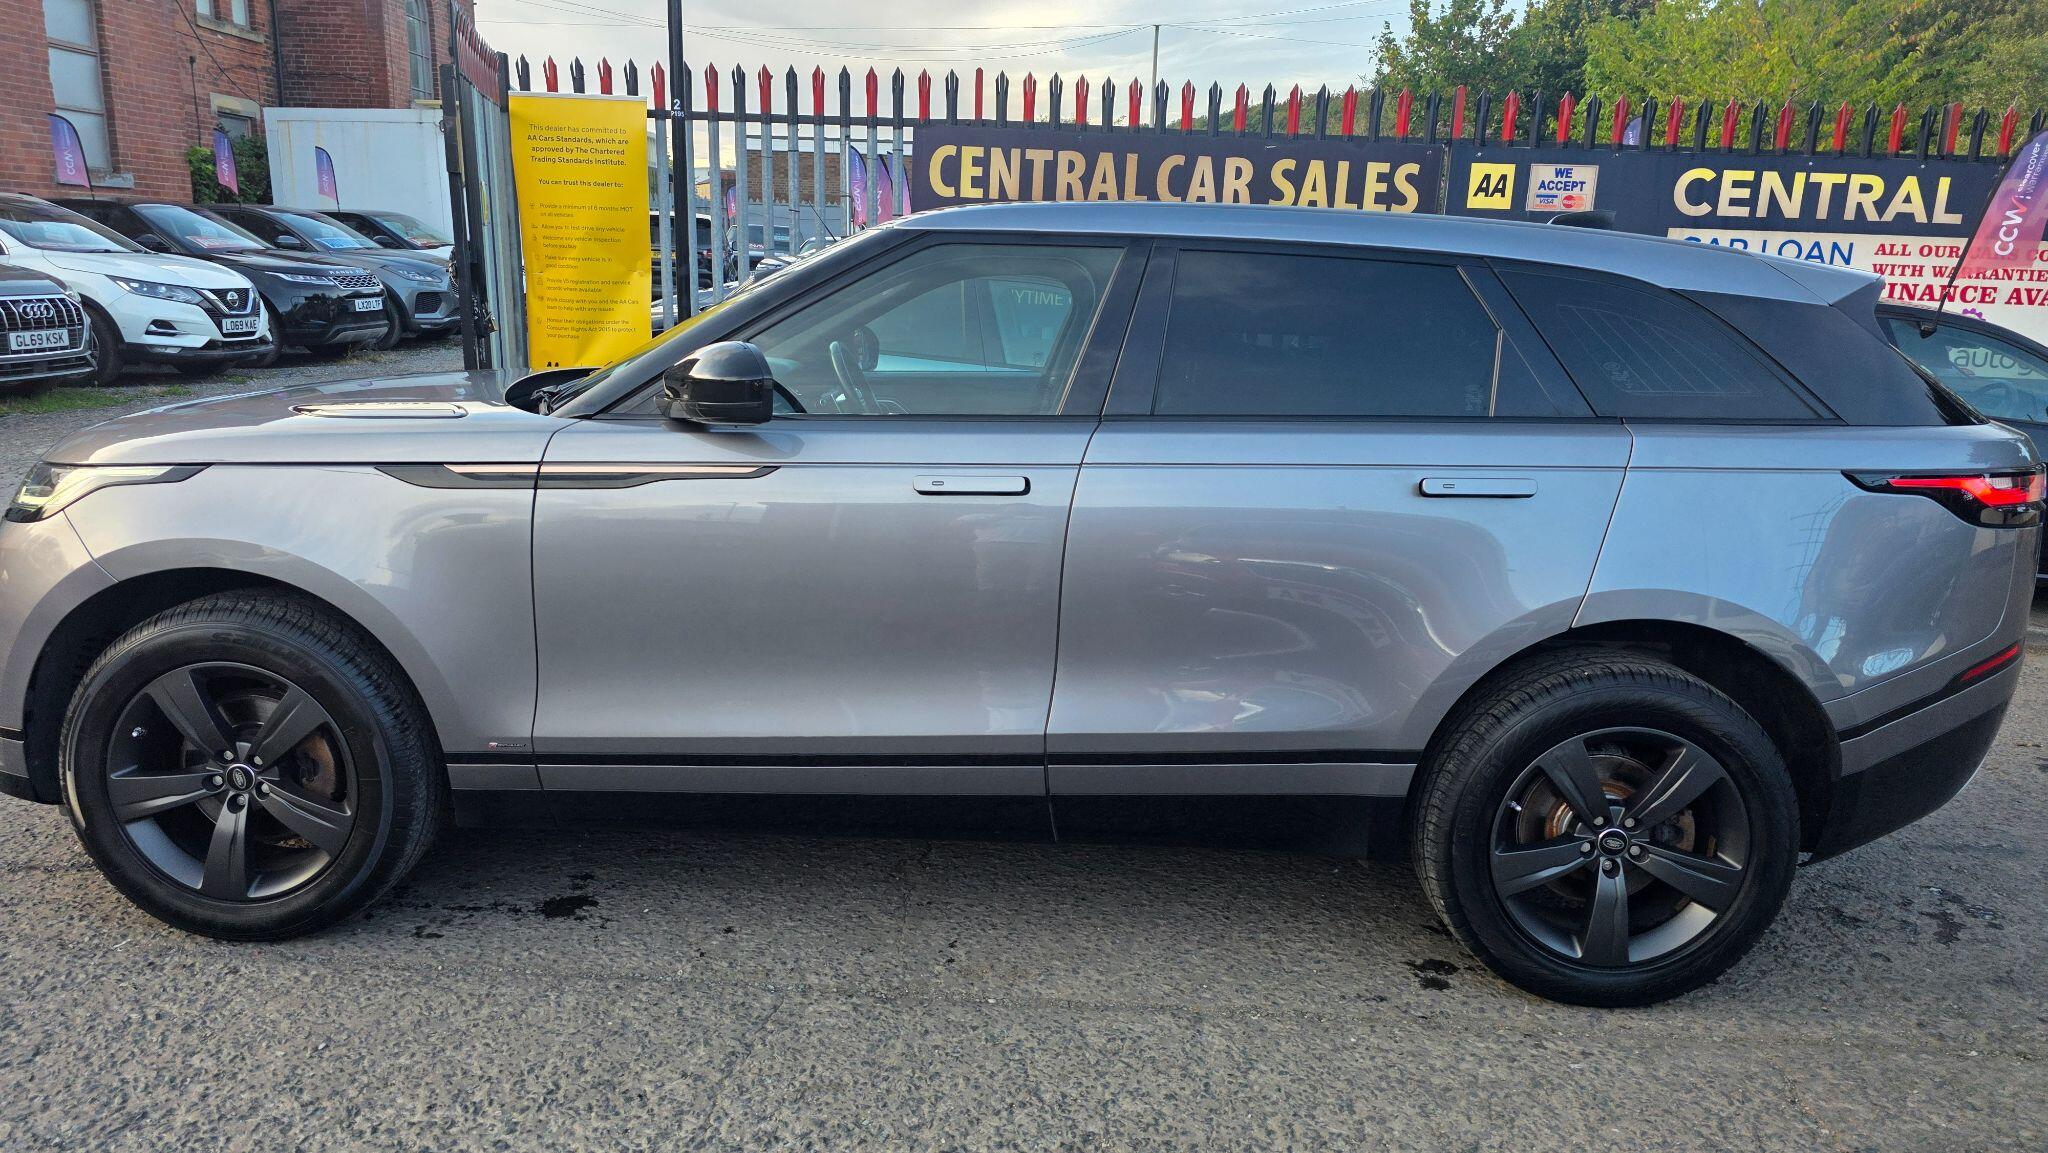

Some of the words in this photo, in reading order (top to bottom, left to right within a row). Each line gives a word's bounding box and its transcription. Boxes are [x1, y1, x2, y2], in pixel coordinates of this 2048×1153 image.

[673, 98, 681, 110] 2
[529, 123, 543, 131] This
[545, 124, 566, 132] dealer
[581, 126, 618, 134] committed
[556, 136, 594, 144] Standards,
[530, 156, 556, 164] Trading
[557, 156, 593, 164] Standards
[594, 158, 627, 166] Institute.
[2017, 142, 2041, 192] clearcover
[928, 144, 1147, 202] CENTRAL
[1155, 154, 1254, 204] CAR
[1267, 158, 1421, 214] SALES
[1554, 167, 1574, 178] WE
[592, 180, 613, 188] dealer
[1473, 173, 1508, 198] AA
[1537, 180, 1587, 191] ACCEPT
[1673, 167, 1963, 225] CENTRAL
[1994, 195, 2027, 256] CCW
[1873, 243, 1912, 257] ALL
[1918, 245, 1962, 259] OUR
[1872, 263, 1925, 278] WITH
[1011, 288, 1064, 306] YTIME
[1881, 282, 1999, 305] INANCE
[357, 301, 372, 310] LX20
[225, 318, 245, 331] LO69
[245, 317, 259, 330] KAE
[15, 333, 44, 348] GL69
[46, 332, 66, 346] KSK
